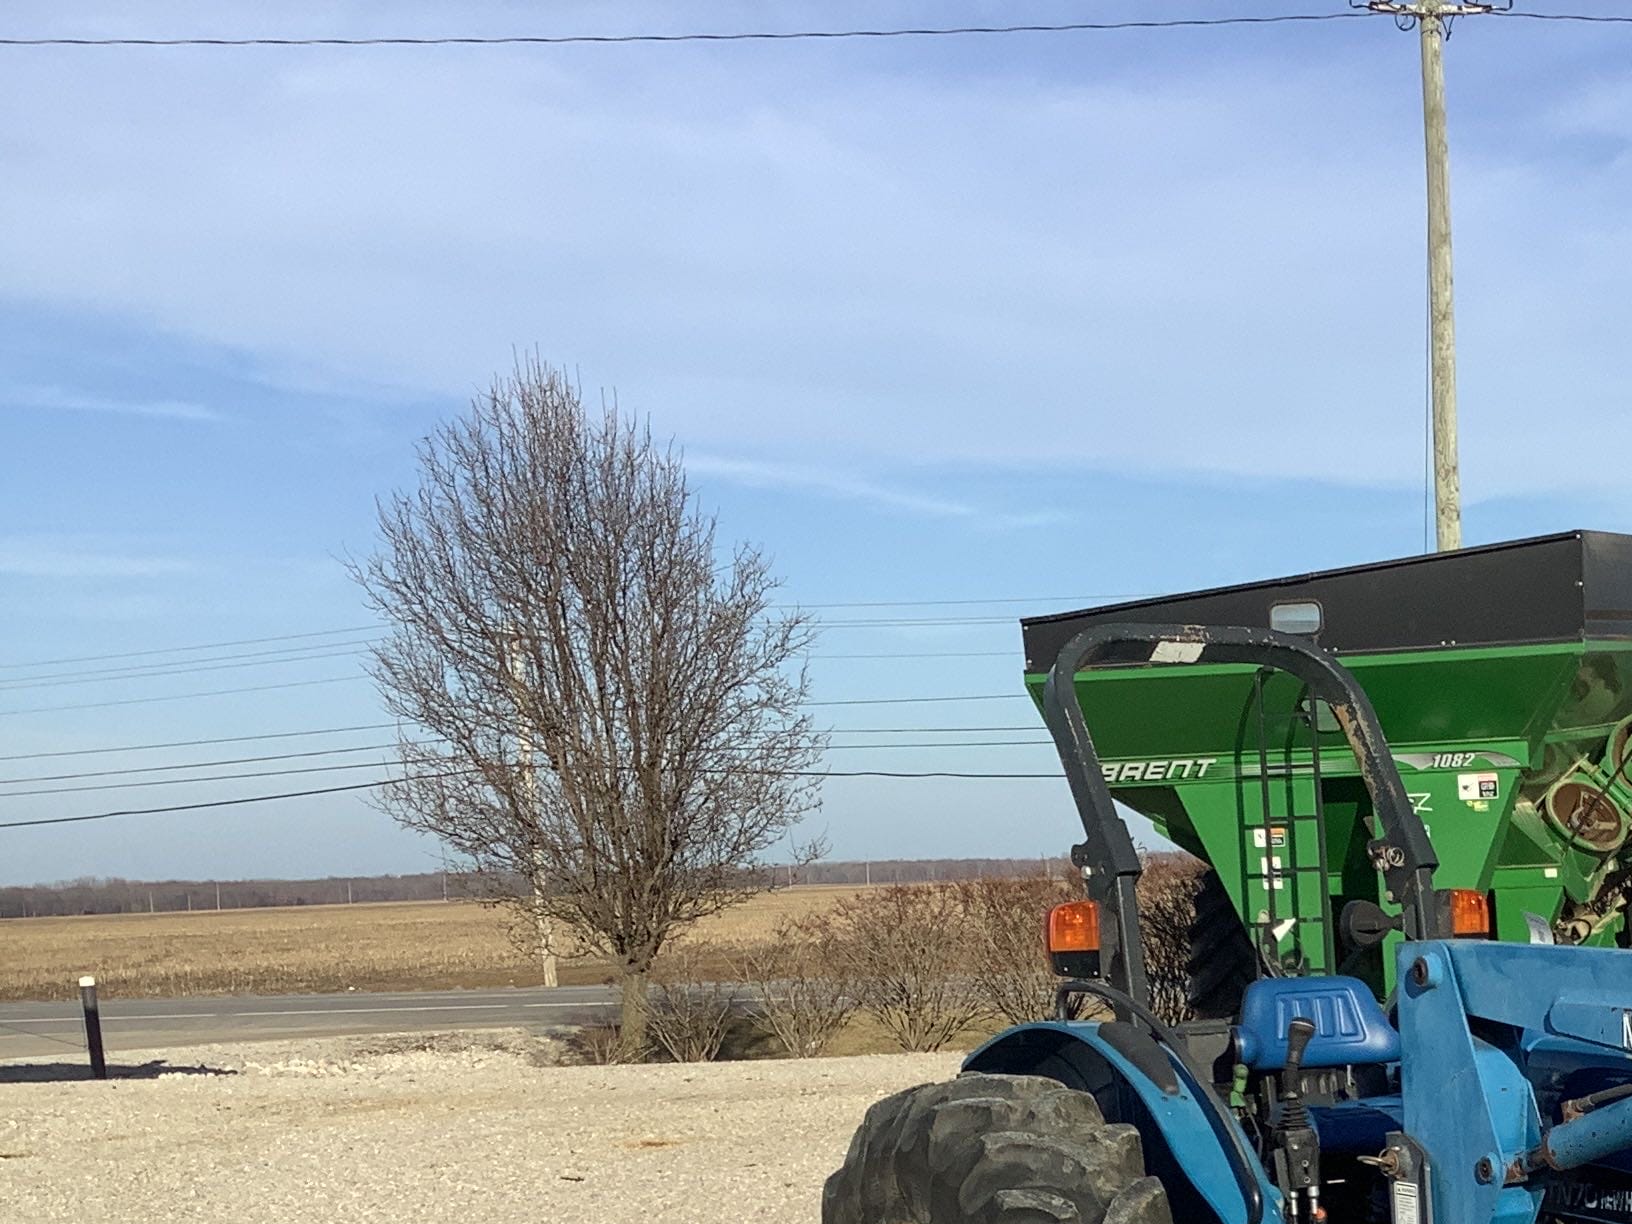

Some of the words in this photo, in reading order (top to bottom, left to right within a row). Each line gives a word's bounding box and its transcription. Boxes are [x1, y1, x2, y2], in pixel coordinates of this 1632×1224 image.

[1101, 758, 1217, 782] BRENT
[1433, 752, 1476, 769] 1082
[1600, 1189, 1625, 1213] NEW
